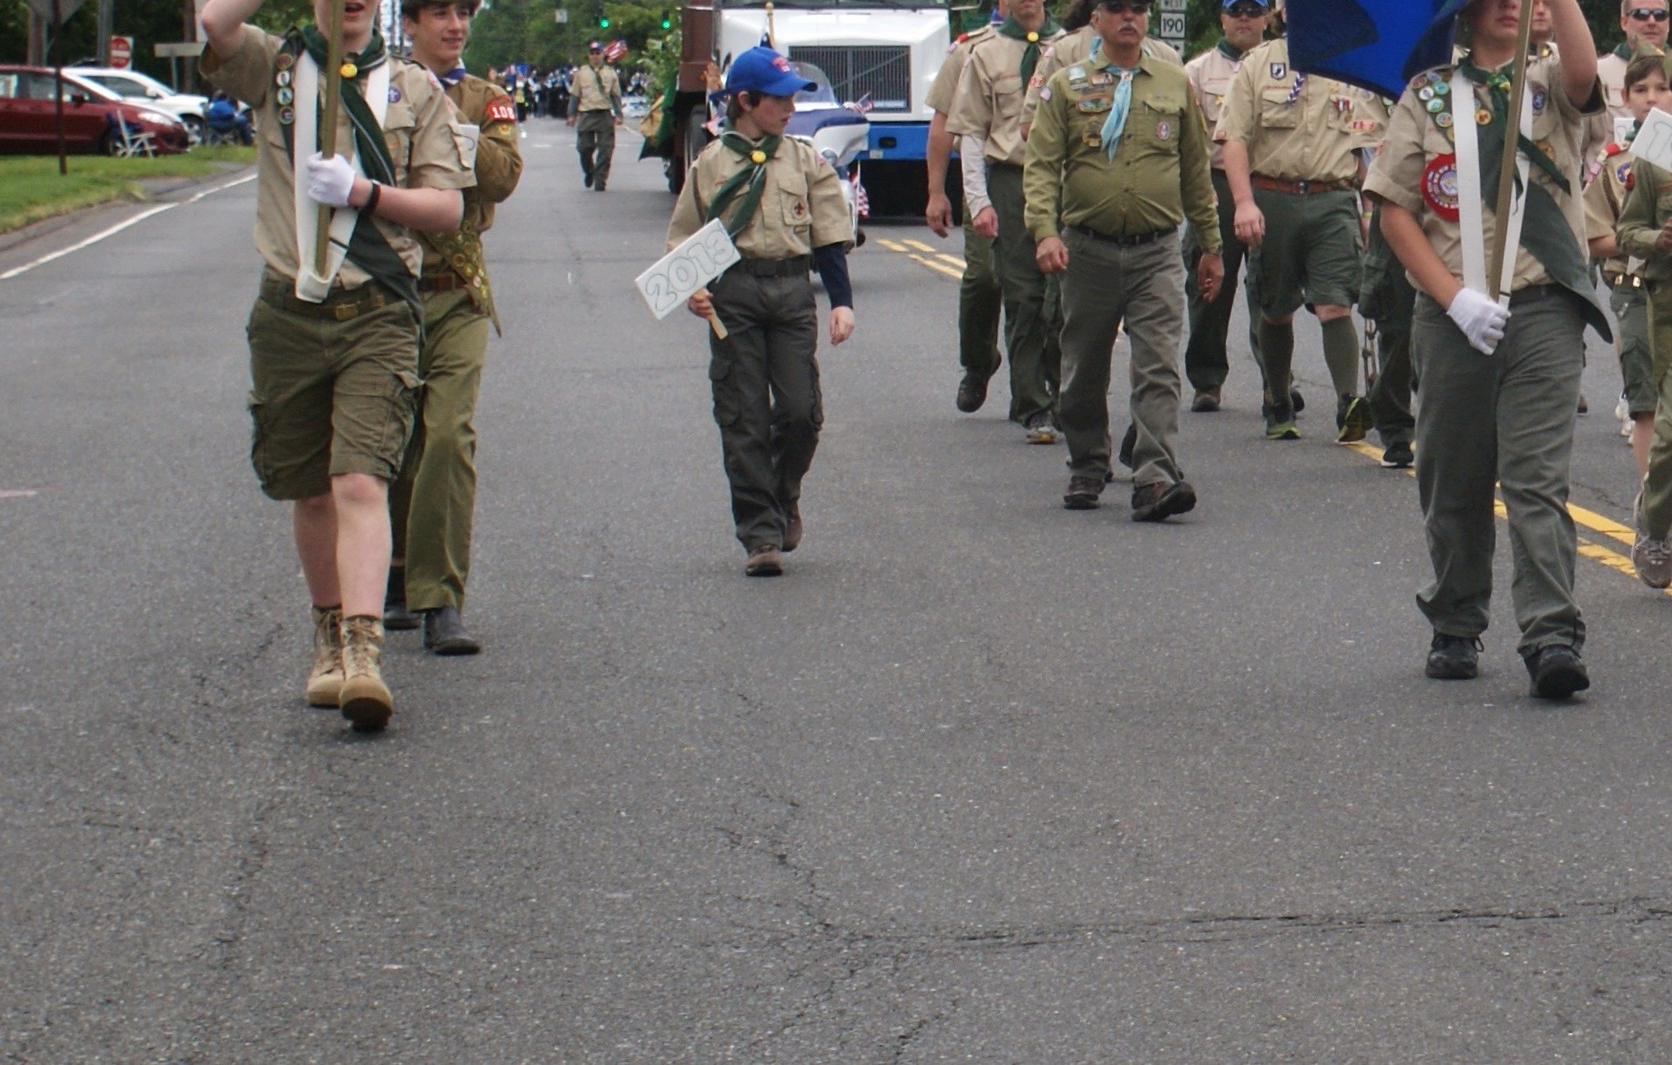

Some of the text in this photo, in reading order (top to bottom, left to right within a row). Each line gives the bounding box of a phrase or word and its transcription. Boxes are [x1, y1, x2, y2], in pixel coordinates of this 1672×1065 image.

[1164, 0, 1183, 8] WEST
[1163, 18, 1183, 33] 190
[492, 106, 515, 120] 108
[645, 229, 735, 312] 2013
